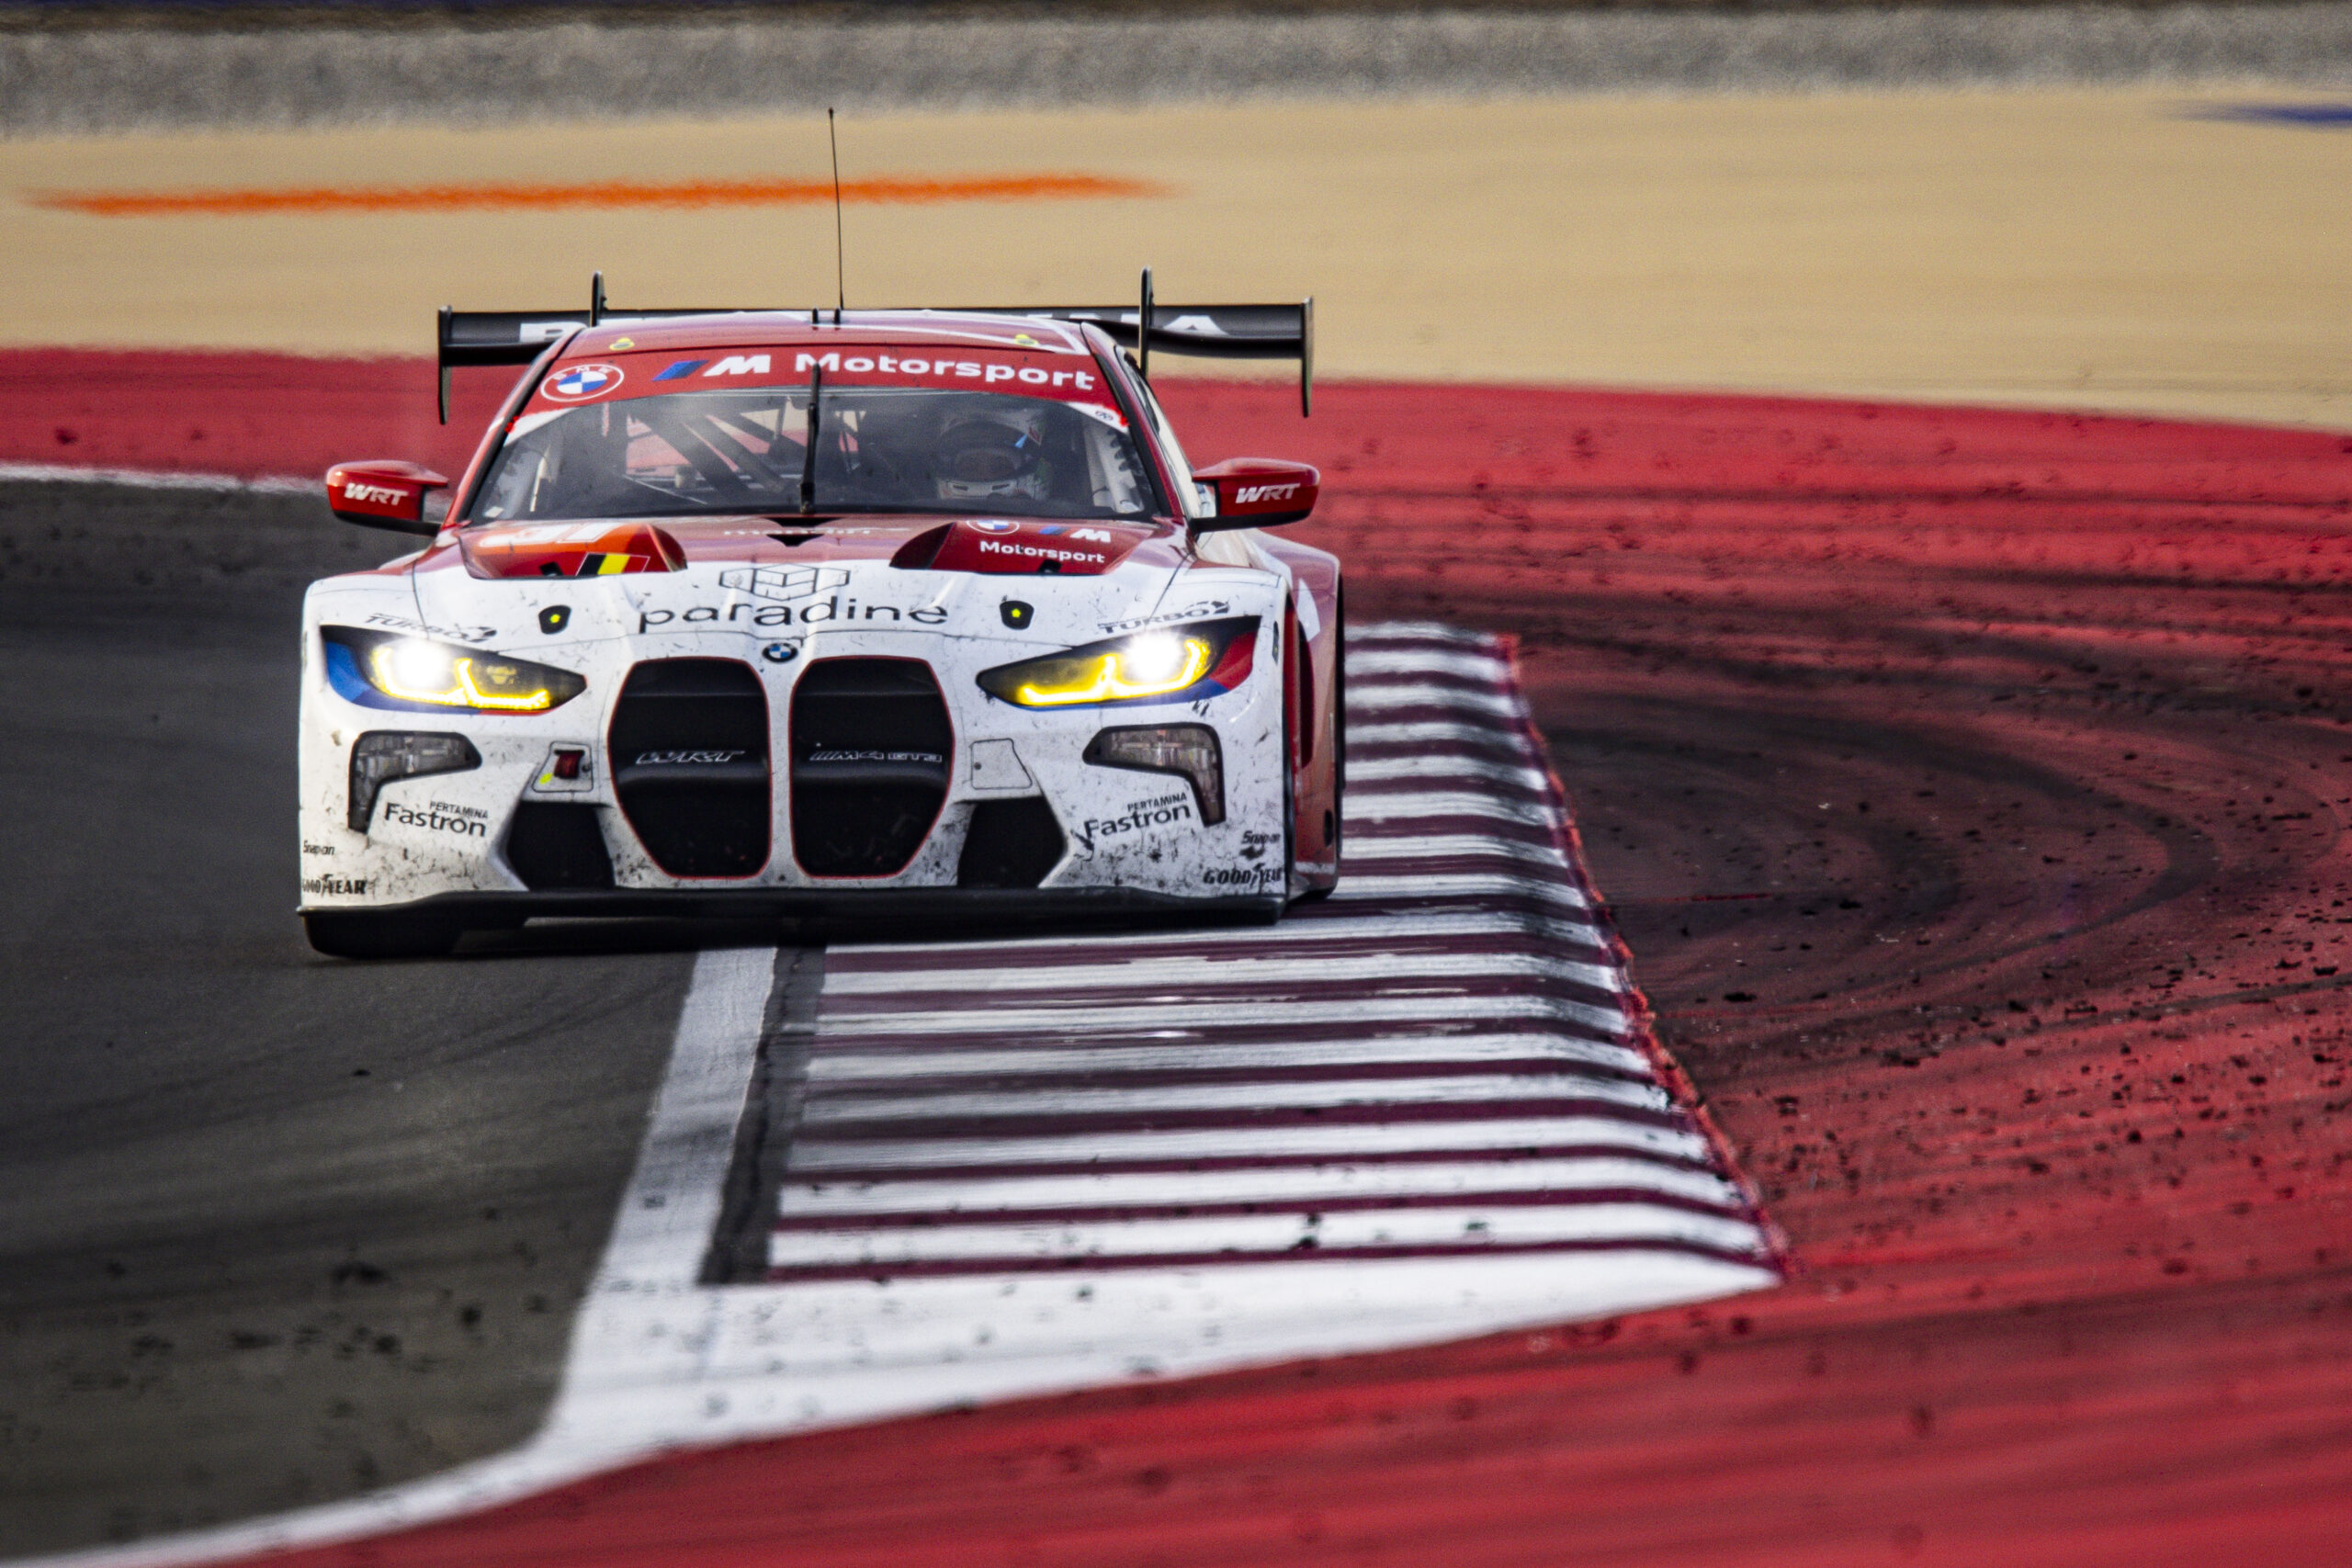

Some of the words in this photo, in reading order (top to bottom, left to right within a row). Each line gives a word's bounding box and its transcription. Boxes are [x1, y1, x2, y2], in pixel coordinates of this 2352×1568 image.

[795, 353, 1095, 391] Motorsport
[344, 482, 409, 506] WRT
[1235, 482, 1301, 503] WRT
[979, 540, 1105, 563] Motorsport
[639, 595, 949, 635] paradine
[429, 800, 489, 819] PERTAMINA
[1126, 791, 1188, 812] PERTAMINA
[384, 801, 487, 838] Fastron
[1083, 804, 1192, 839] Fastron
